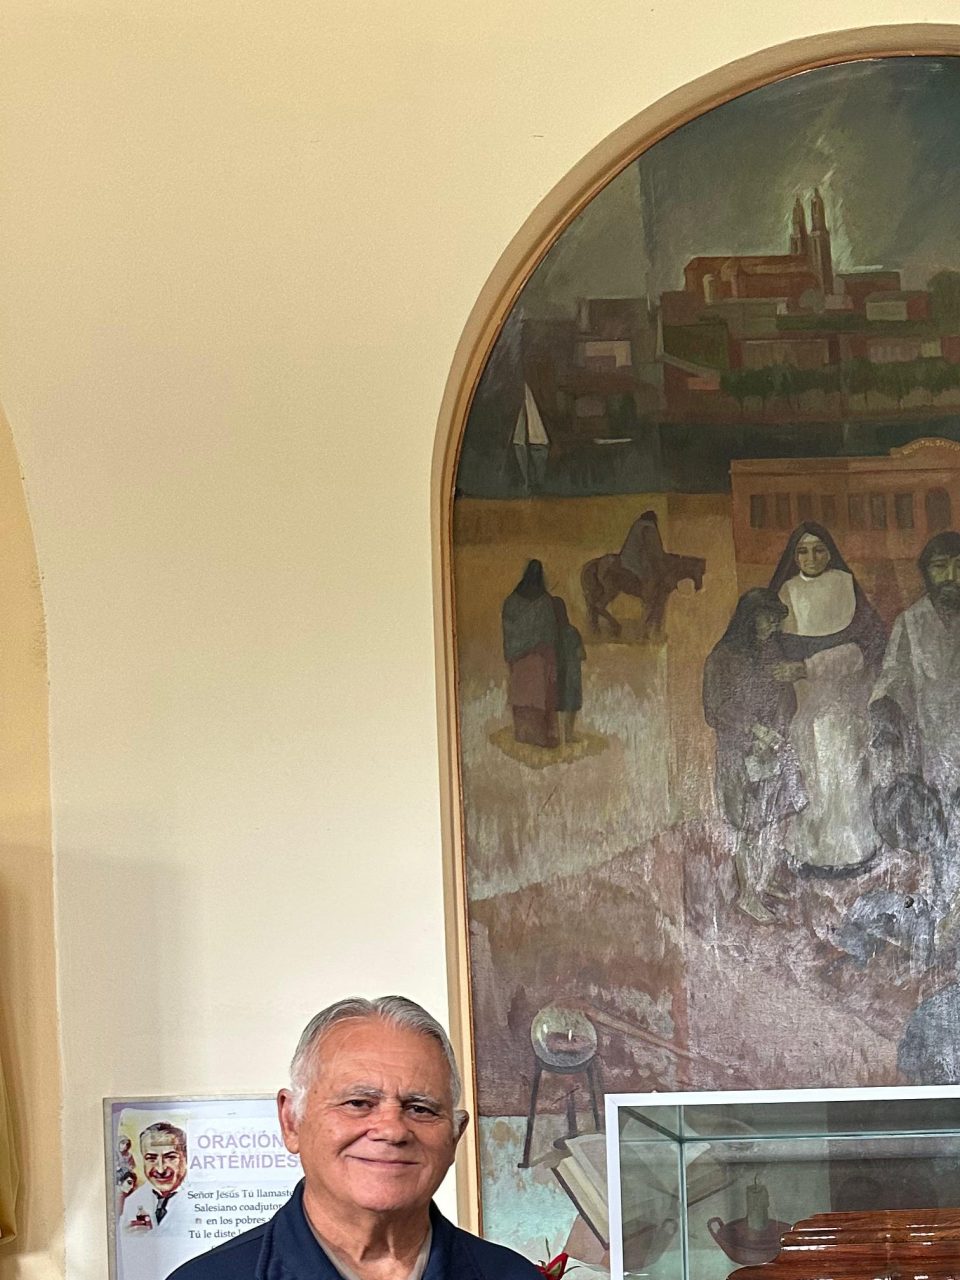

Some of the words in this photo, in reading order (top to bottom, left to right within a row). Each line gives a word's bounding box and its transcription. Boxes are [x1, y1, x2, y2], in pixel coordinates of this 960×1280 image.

[197, 1130, 283, 1149] ORACIÓN
[190, 1151, 298, 1169] ARTÉMIDES
[188, 1190, 214, 1199] Señor
[216, 1189, 239, 1200] Jesús
[194, 1203, 237, 1212] Salesiano
[220, 1216, 233, 1225] los
[203, 1230, 212, 1239] le
[213, 1229, 236, 1238] diste
